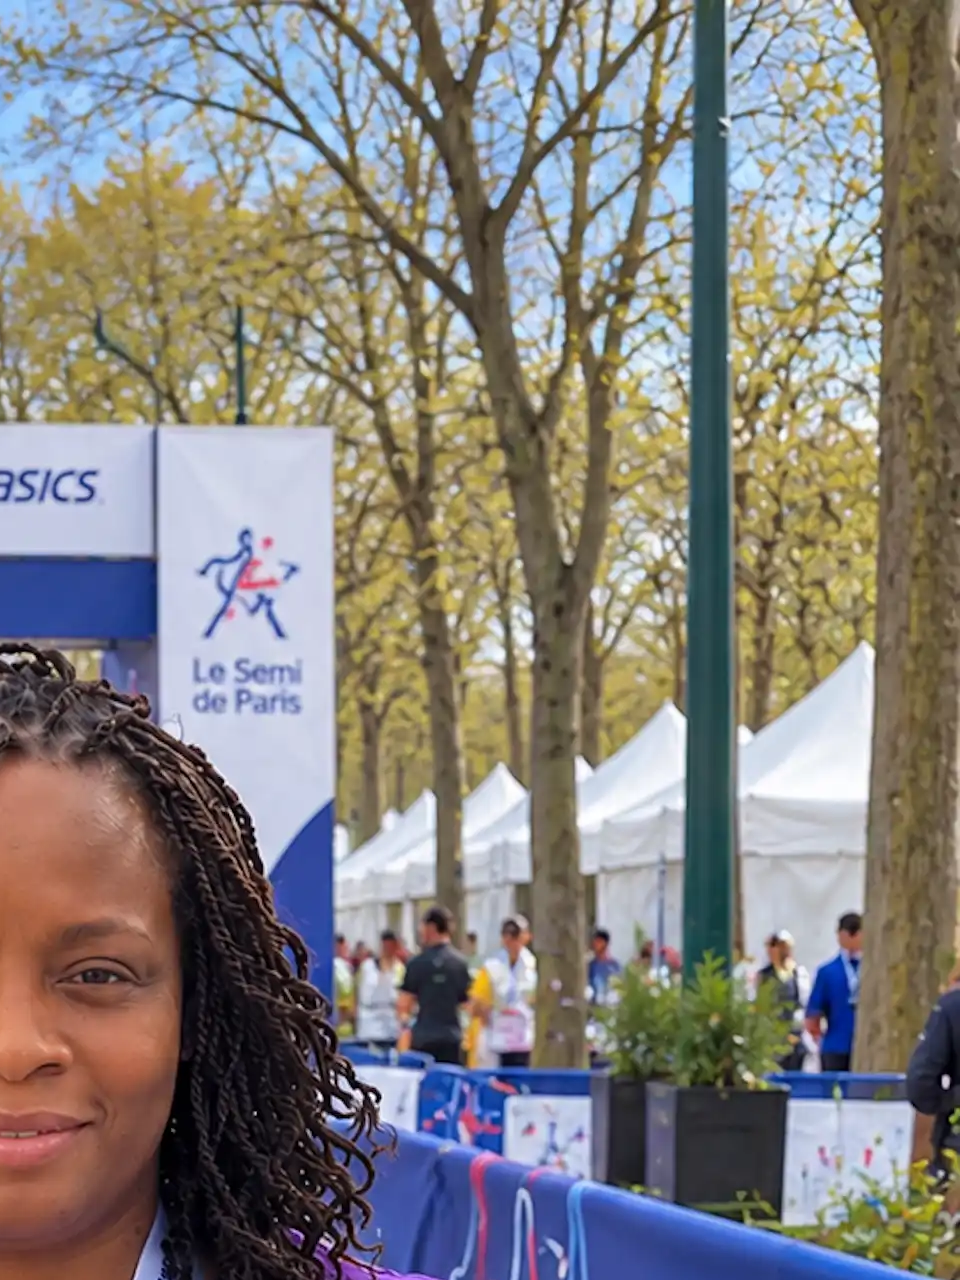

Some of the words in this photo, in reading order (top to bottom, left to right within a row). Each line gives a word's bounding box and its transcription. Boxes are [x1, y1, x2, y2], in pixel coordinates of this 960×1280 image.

[192, 657, 226, 684] Le
[234, 657, 302, 684] Semi
[192, 688, 227, 714] de
[235, 688, 302, 715] Paris
